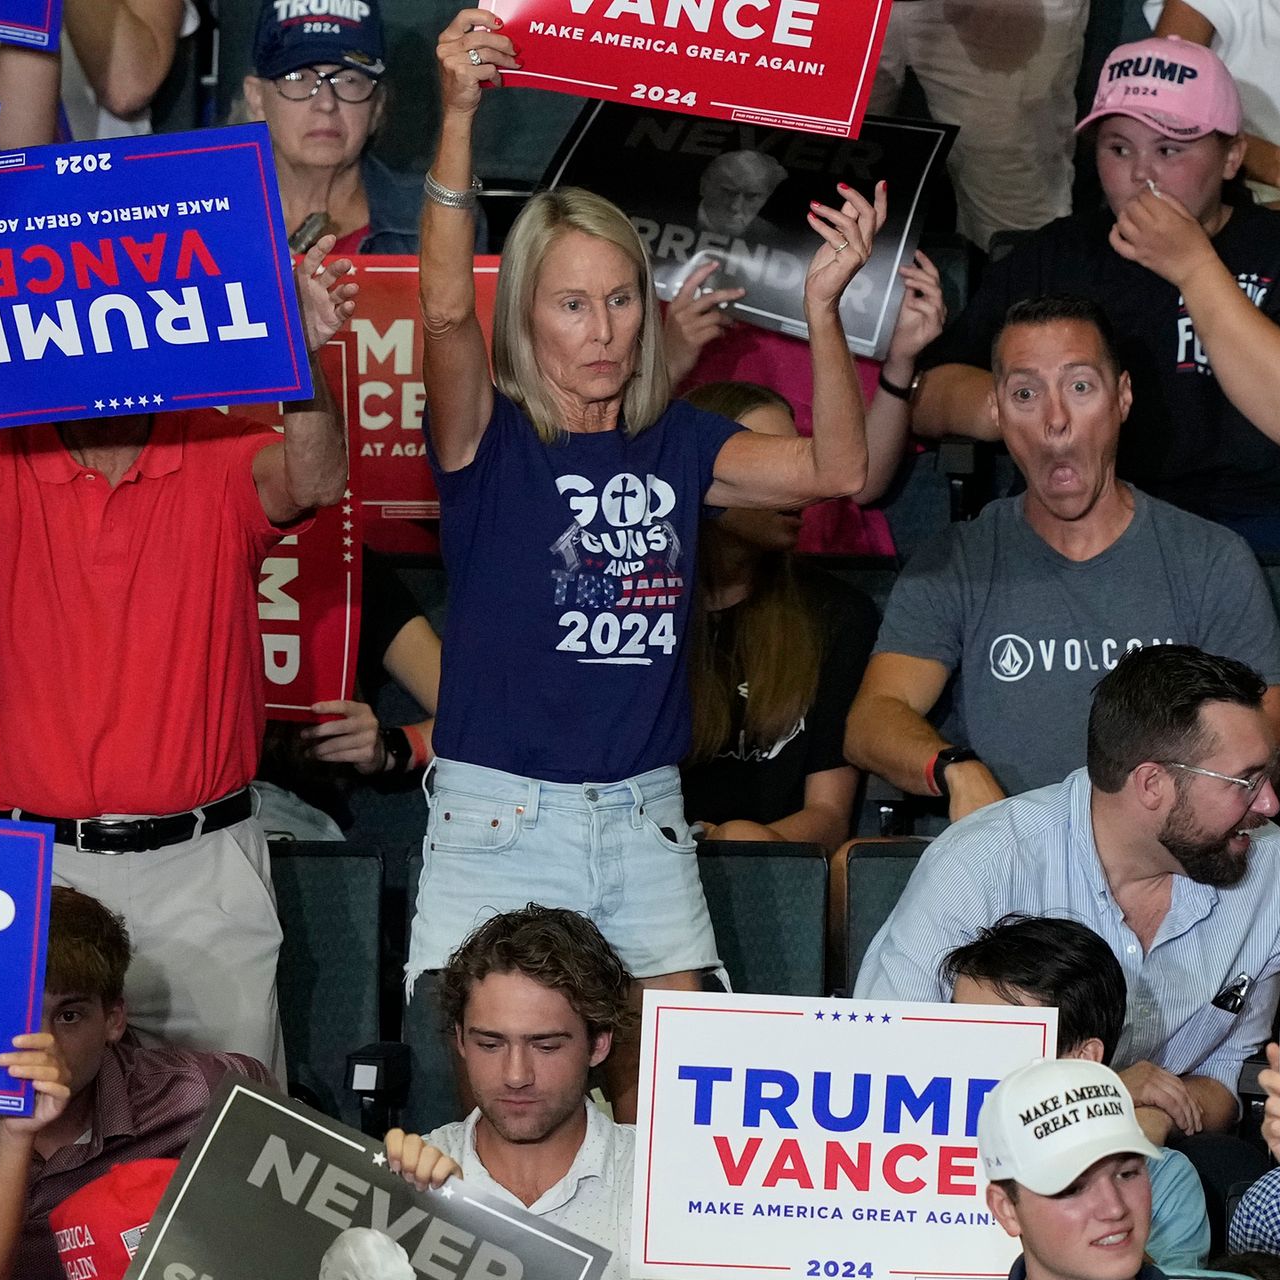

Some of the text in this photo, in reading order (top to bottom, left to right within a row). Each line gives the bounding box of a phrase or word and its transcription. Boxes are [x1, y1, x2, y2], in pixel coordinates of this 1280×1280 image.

[304, 22, 340, 33] 2024
[529, 21, 824, 75] MAKE AMERICA GREAT AGAIN!
[1108, 57, 1197, 84] TRUMP
[631, 84, 696, 106] 2024
[1124, 86, 1157, 96] 2024
[56, 153, 111, 174] 2024
[554, 472, 677, 527] GOD
[580, 525, 668, 560] GUNS
[603, 560, 645, 577] AND
[556, 611, 677, 655] 2024
[1018, 1085, 1122, 1127] MAKE AMERICA
[1033, 1101, 1125, 1141] GREAT AGAIN
[713, 1136, 978, 1196] VANCE
[689, 1201, 995, 1225] MAKE AMERICA GREAT AGAIN!
[807, 1260, 873, 1278] 2024
